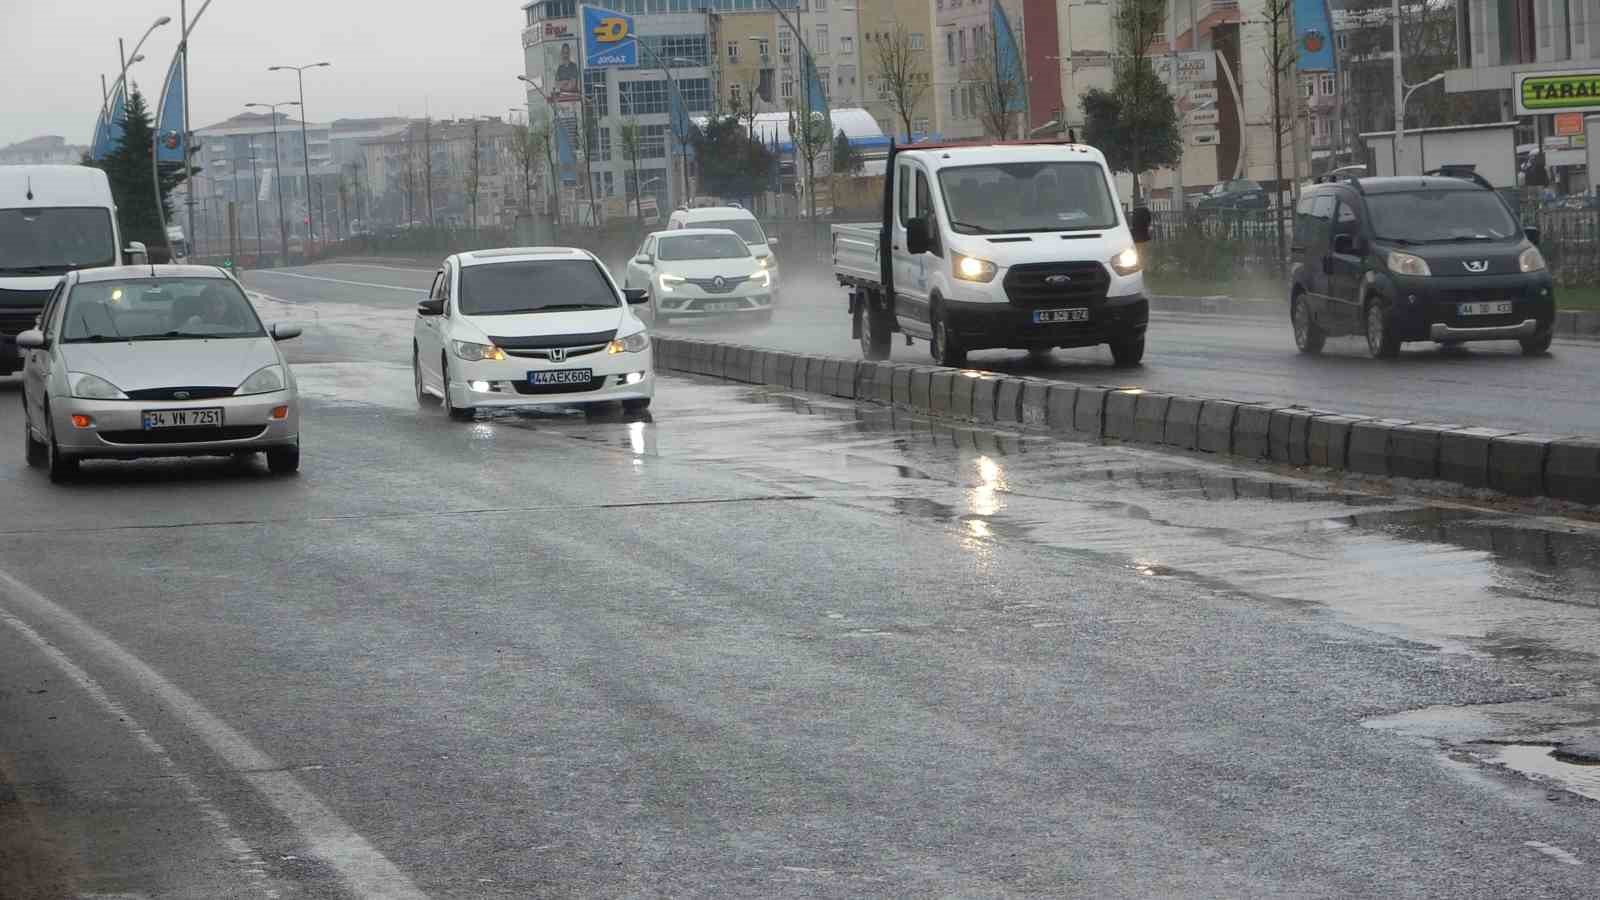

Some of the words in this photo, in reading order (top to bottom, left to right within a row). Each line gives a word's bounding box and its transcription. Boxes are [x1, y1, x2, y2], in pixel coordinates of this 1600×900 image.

[151, 413, 165, 426] 34
[172, 412, 186, 425] VN
[191, 411, 219, 424] 7251
